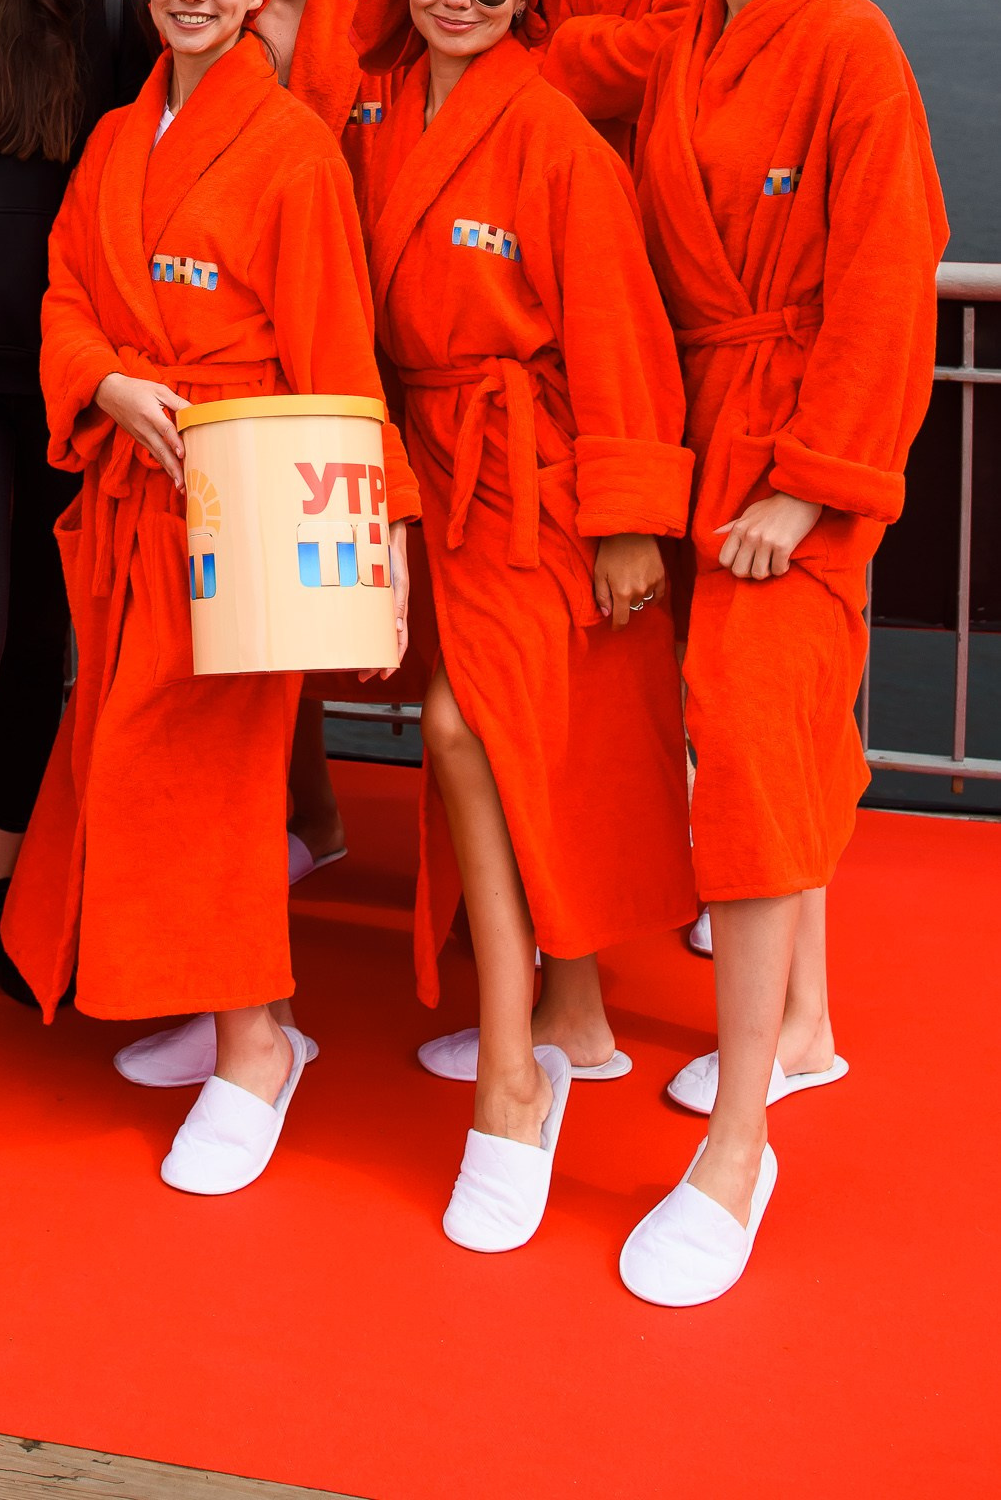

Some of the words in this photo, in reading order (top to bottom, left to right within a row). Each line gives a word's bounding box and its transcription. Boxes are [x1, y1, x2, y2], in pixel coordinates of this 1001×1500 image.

[347, 101, 383, 125] НТ
[451, 218, 522, 263] ТНТ
[152, 253, 219, 291] ТНТ
[294, 462, 386, 516] УТР
[296, 521, 394, 588] ТН
